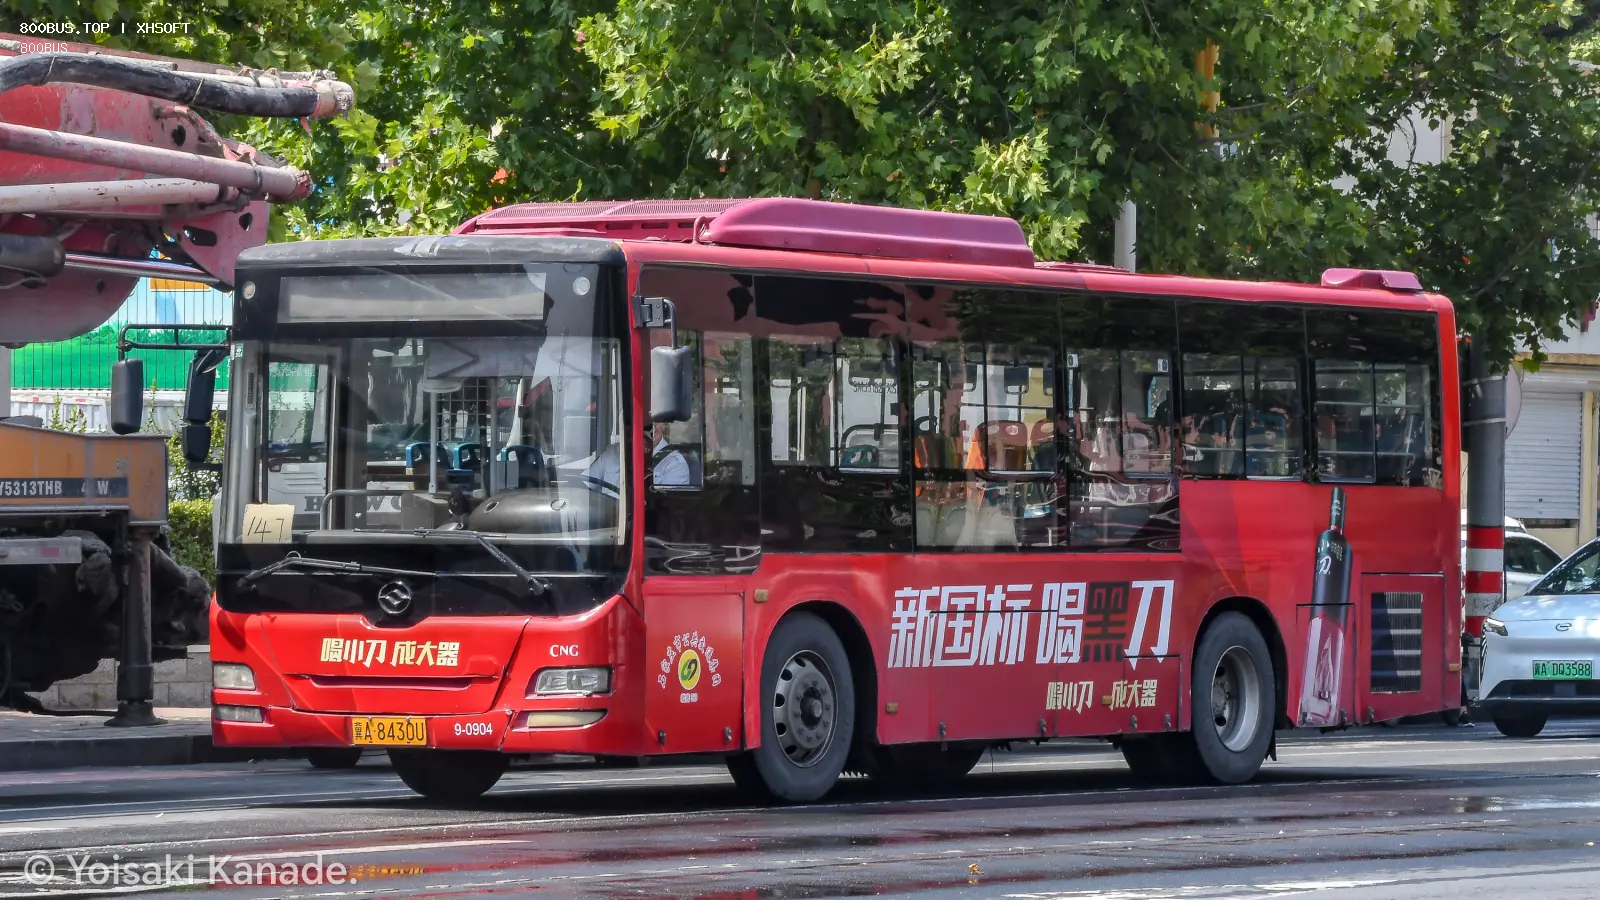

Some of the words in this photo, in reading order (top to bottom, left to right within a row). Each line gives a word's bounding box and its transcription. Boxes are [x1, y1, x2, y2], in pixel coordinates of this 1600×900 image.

[247, 516, 285, 544] 147
[887, 584, 1033, 668] 新国标
[1035, 579, 1175, 670] 喝黑刀
[320, 637, 388, 668] 喝小刀
[390, 640, 460, 667] 成大器
[549, 644, 579, 657] CNG
[1552, 663, 1591, 676] DQ3588
[1046, 681, 1094, 714] 喝小刀
[1109, 679, 1158, 711] 成大器
[454, 722, 493, 736] 9-0904
